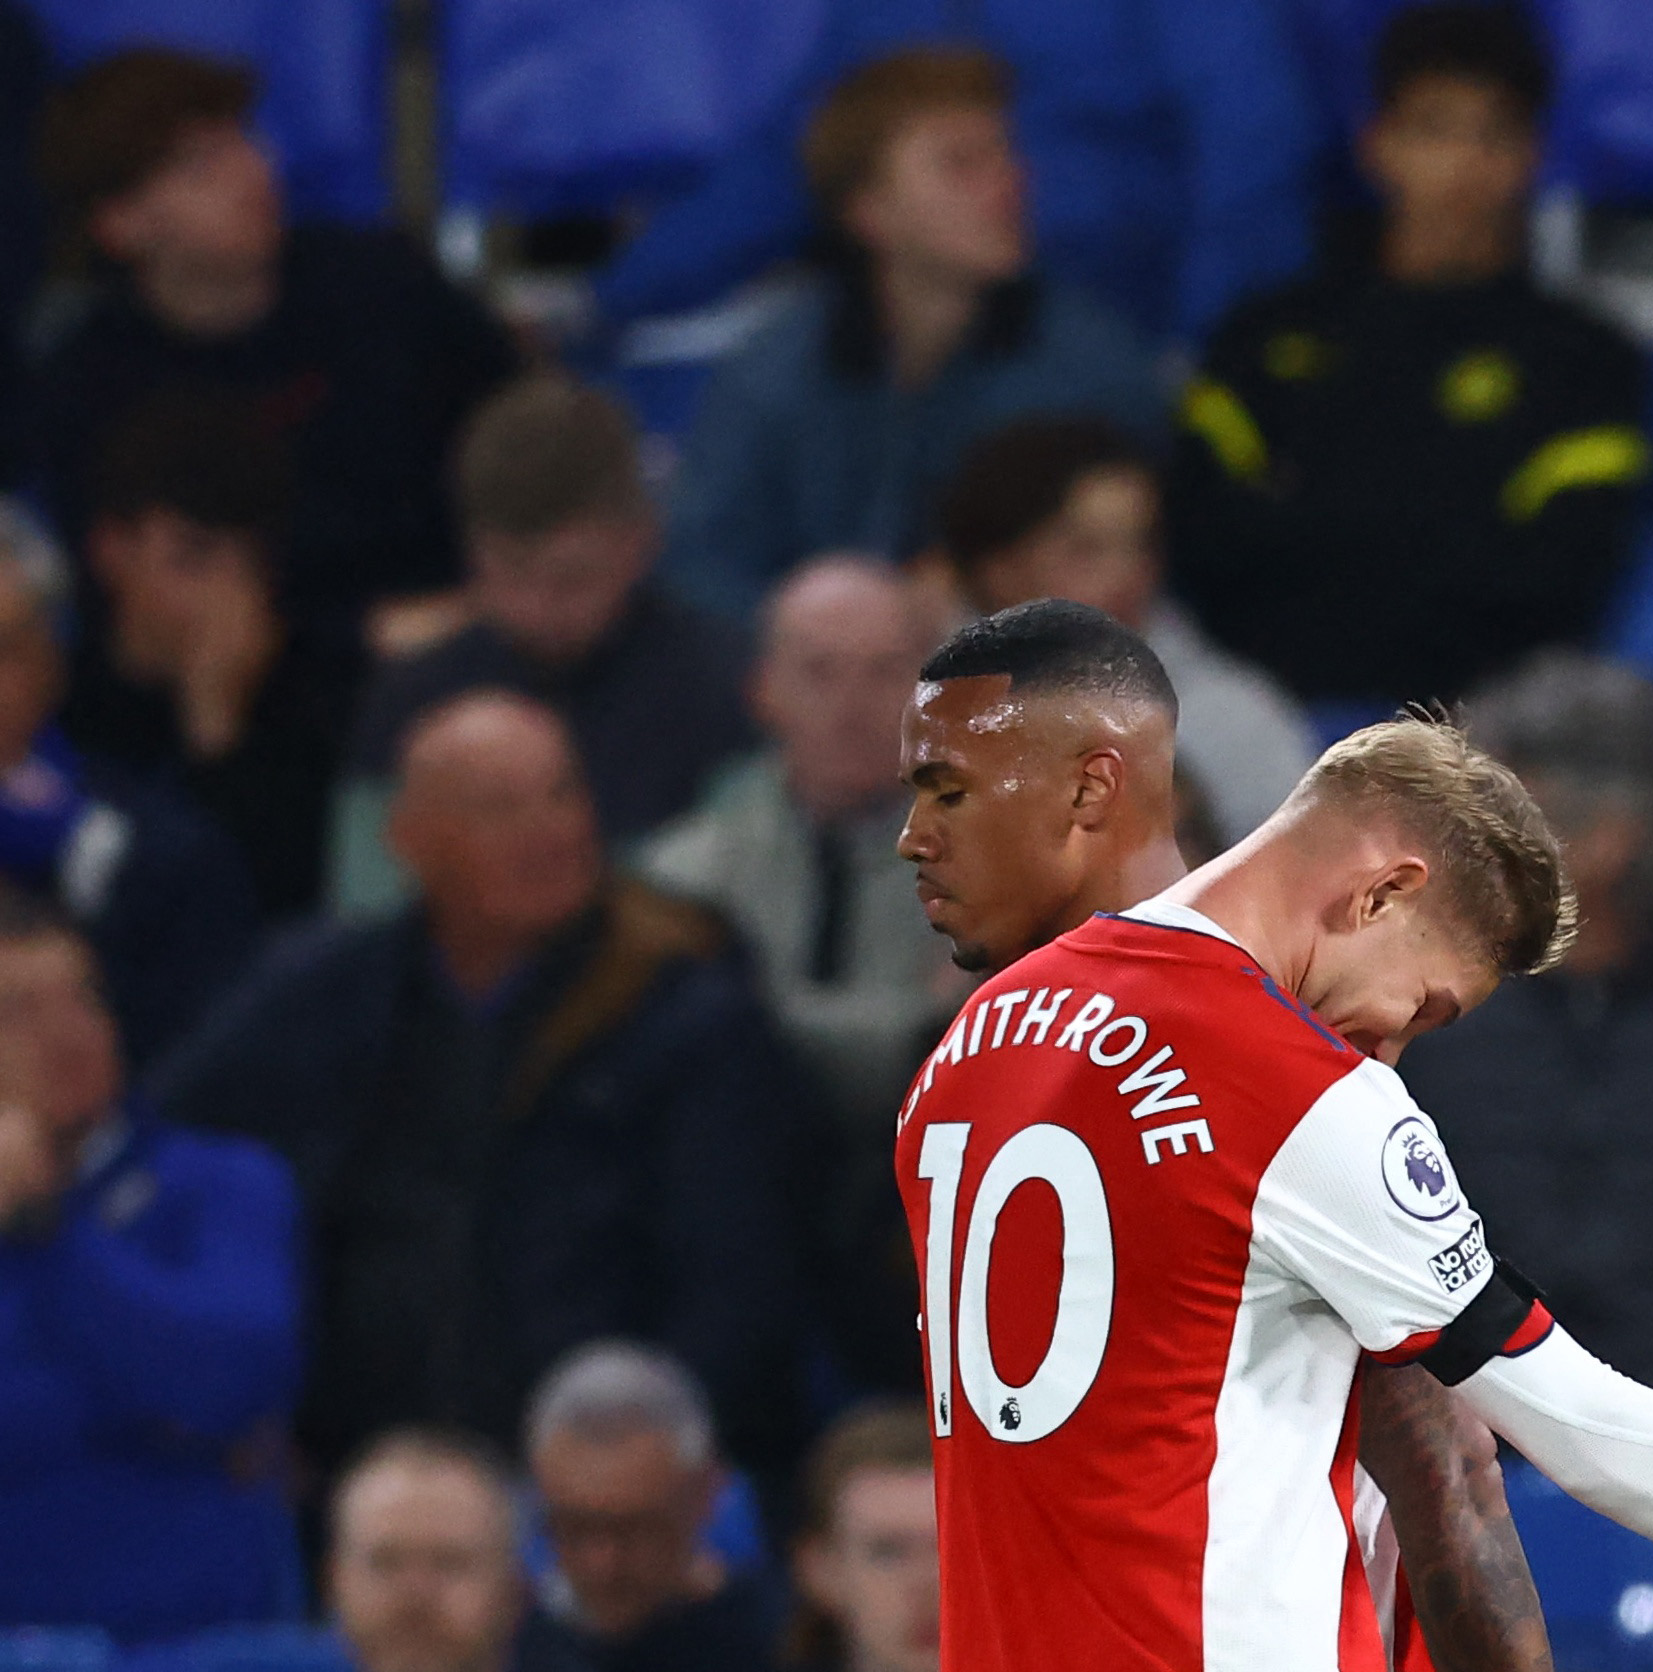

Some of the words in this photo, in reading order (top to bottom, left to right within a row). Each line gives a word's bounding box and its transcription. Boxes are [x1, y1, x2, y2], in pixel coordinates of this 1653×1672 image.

[1054, 991, 1215, 1165] ROWE
[918, 1122, 1114, 1443] 10
[1430, 1252, 1461, 1276] No
